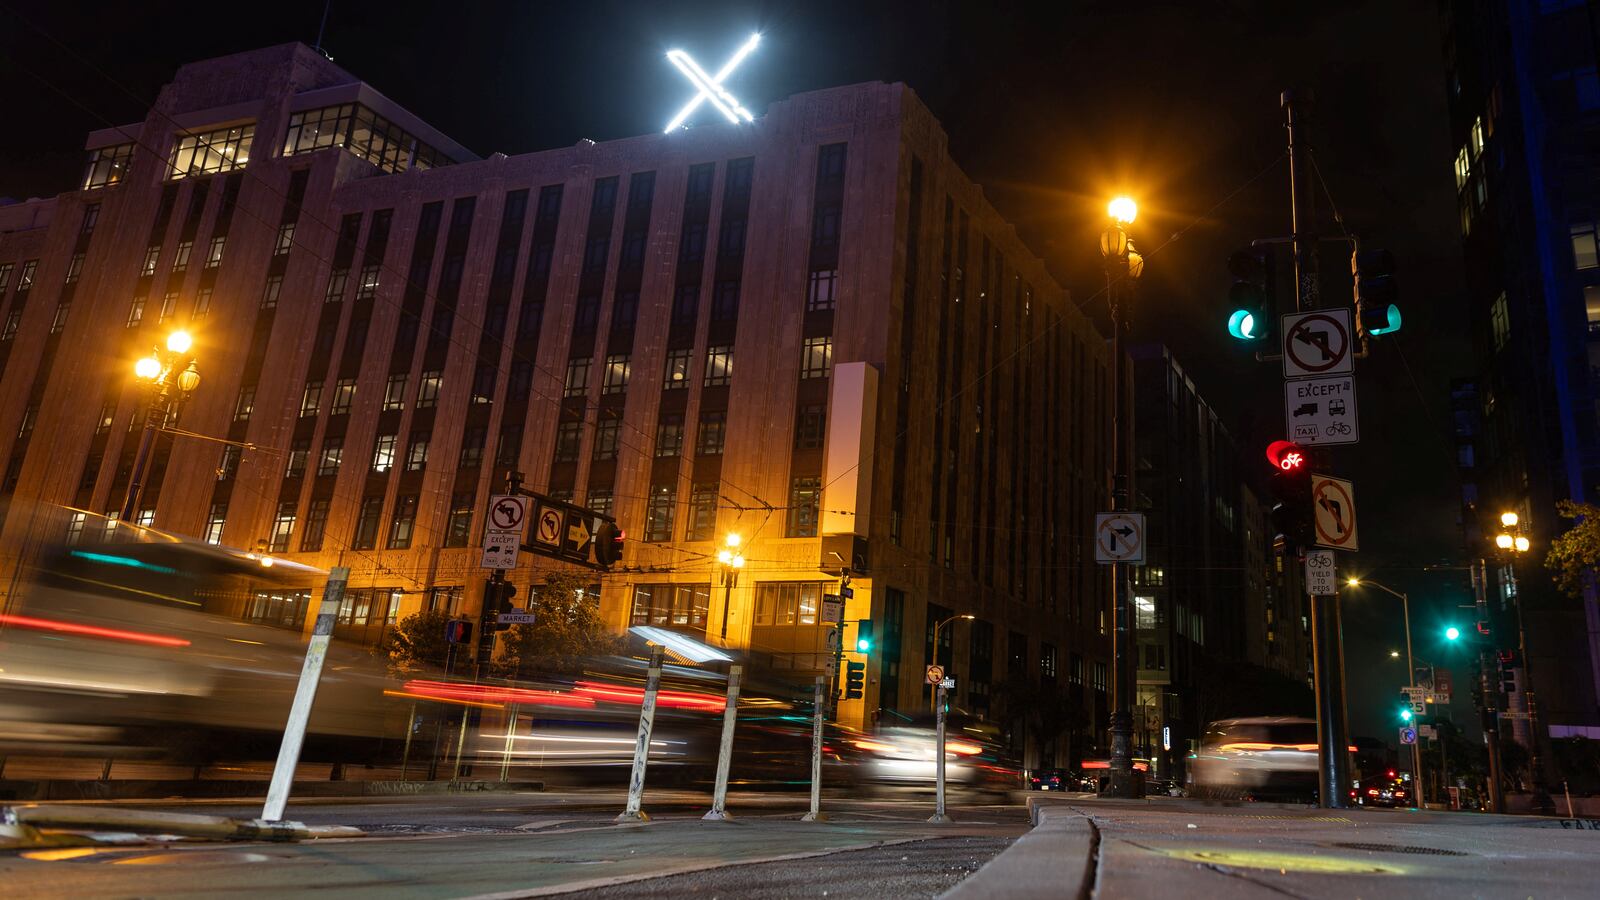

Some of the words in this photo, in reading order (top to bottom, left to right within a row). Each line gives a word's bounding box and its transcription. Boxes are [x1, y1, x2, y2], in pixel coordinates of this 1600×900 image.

[1297, 384, 1342, 398] EXCEPT
[1296, 427, 1316, 436] TAXI
[491, 536, 514, 544] EXCEPT
